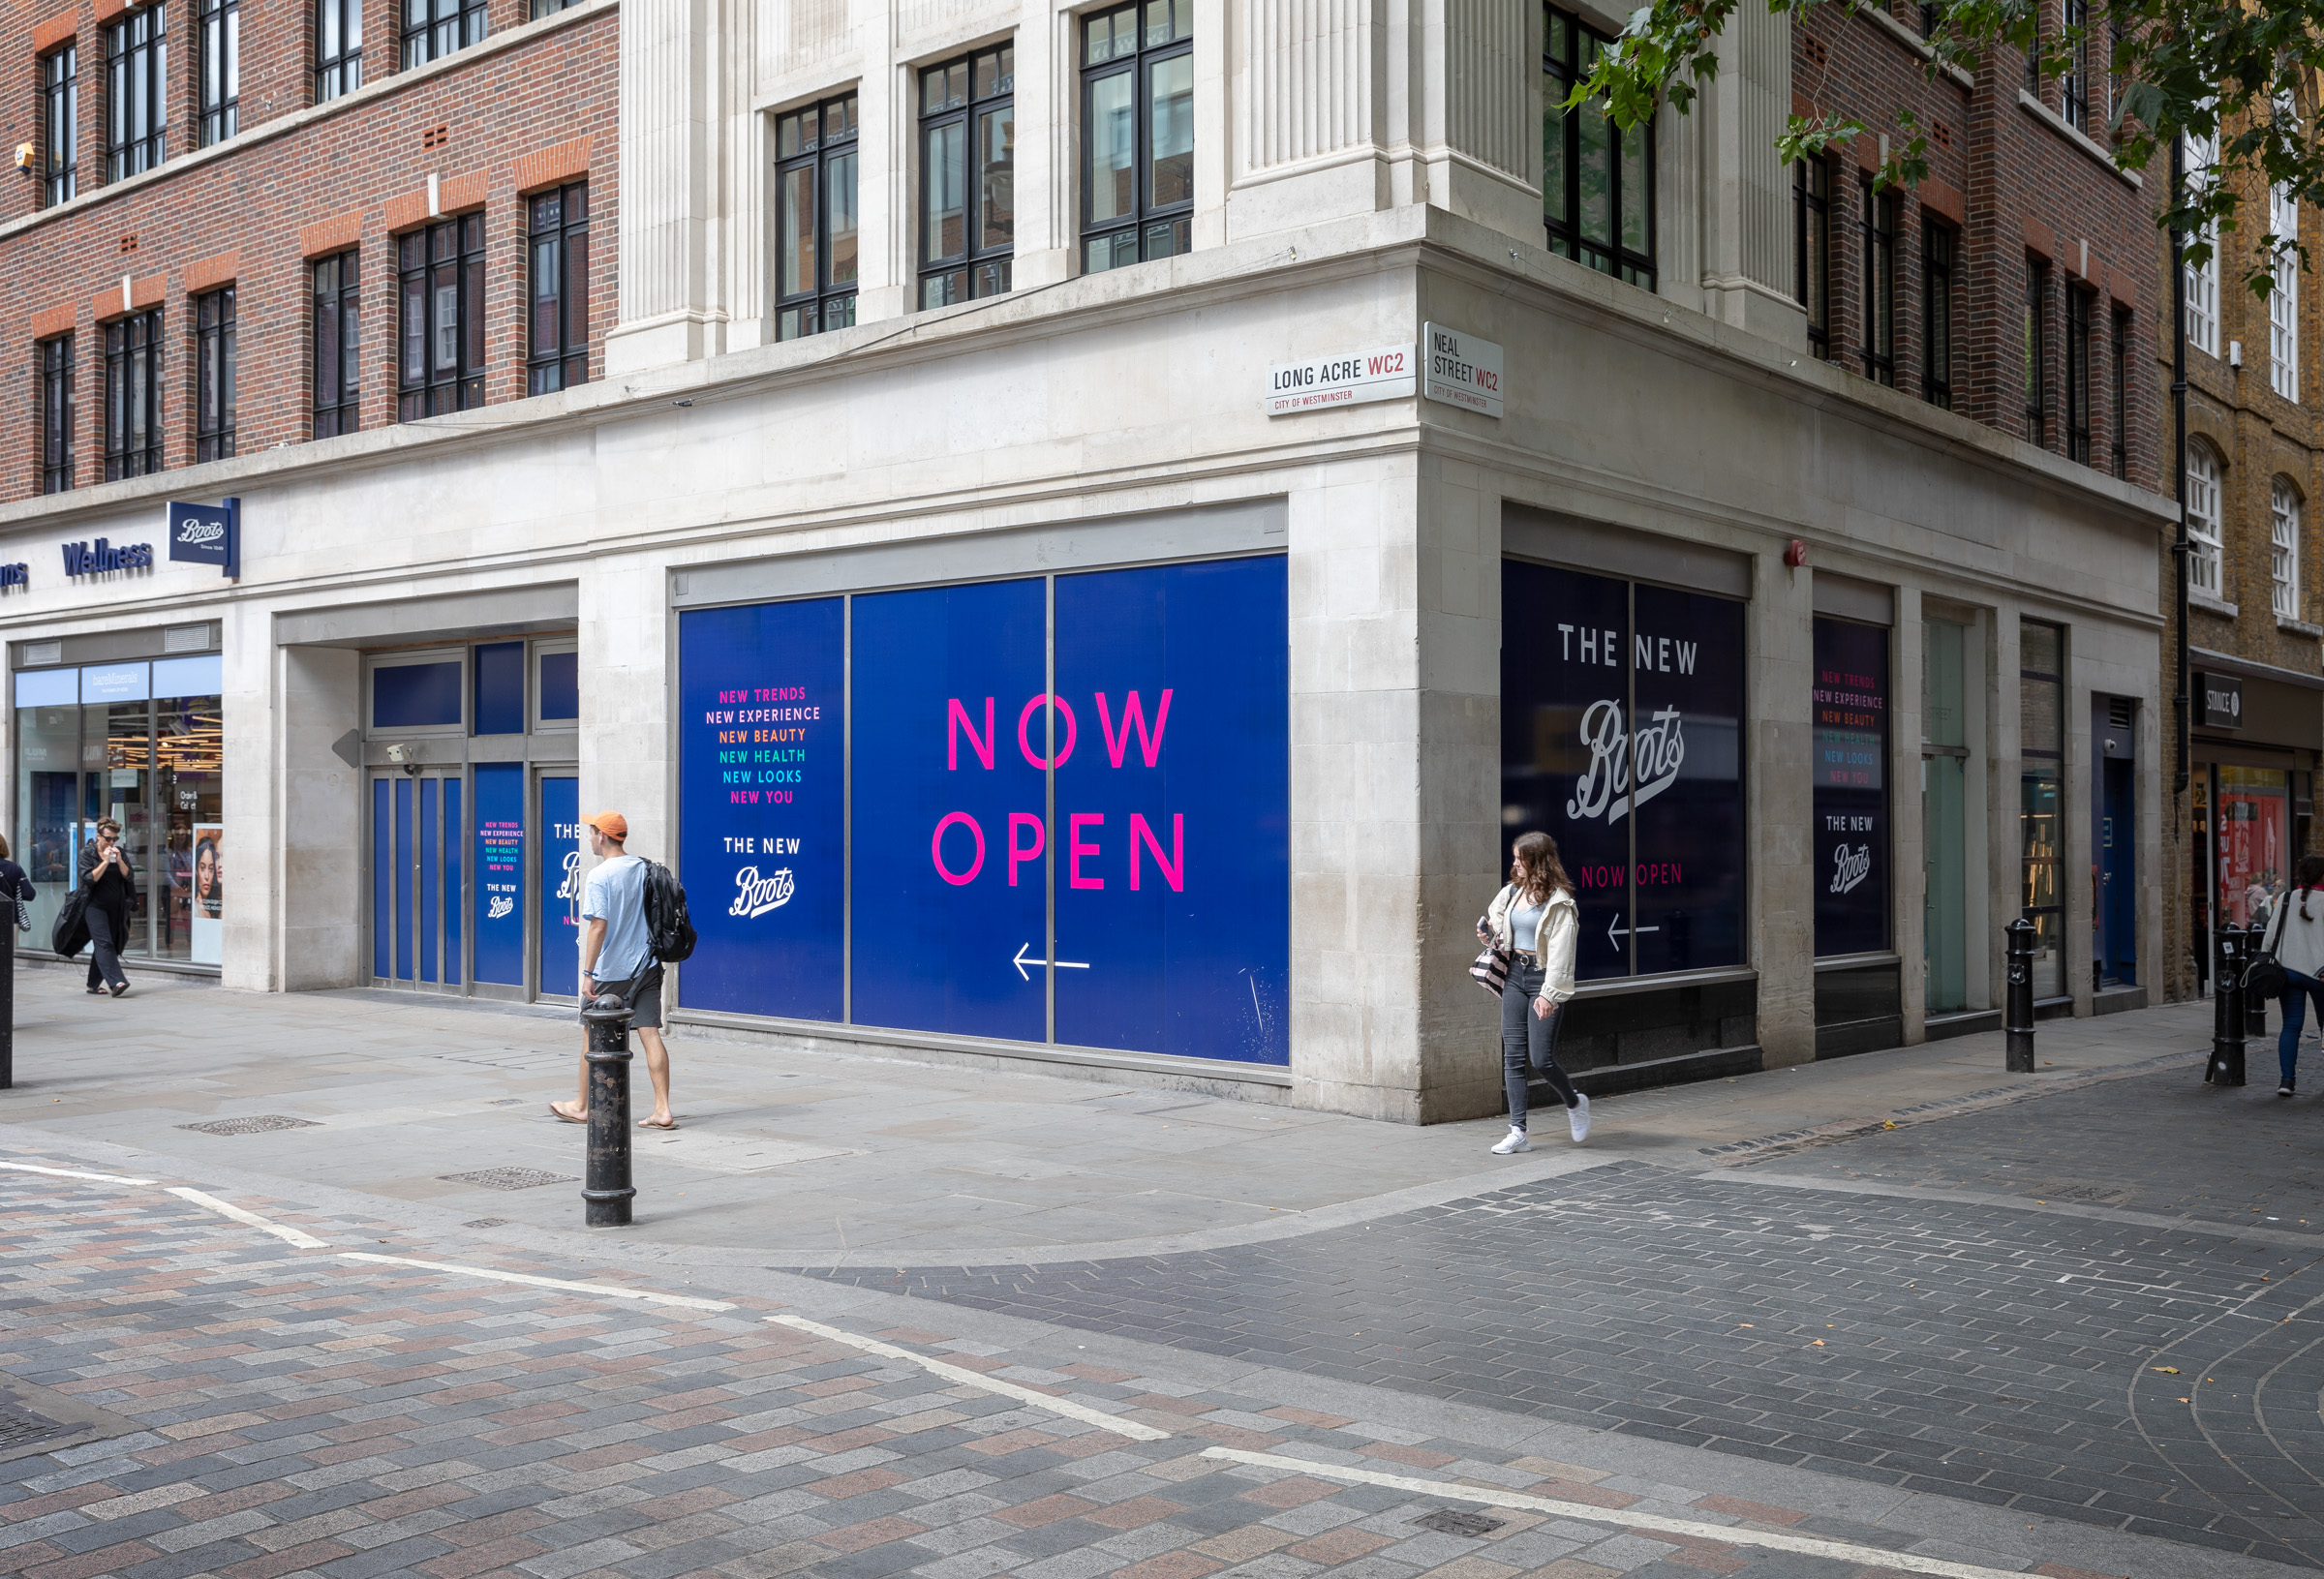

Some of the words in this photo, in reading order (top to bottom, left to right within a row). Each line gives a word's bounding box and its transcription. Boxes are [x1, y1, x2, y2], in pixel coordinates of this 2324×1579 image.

[1434, 332, 1460, 358] NEAL
[1274, 367, 1315, 390] LONG
[1320, 359, 1361, 383] ACRE
[1367, 352, 1404, 376] WC2
[1434, 355, 1474, 383] STREET
[1476, 368, 1499, 392] WC2
[1274, 399, 1290, 410] CITY
[1292, 396, 1301, 408] OF
[1302, 390, 1354, 407] WESTMINSTER
[1433, 384, 1446, 396] CITY
[1446, 387, 1453, 399] OF
[1453, 389, 1488, 410] WESTMINSTER
[176, 518, 225, 544] Boots
[62, 537, 153, 577] Wellness
[0, 562, 29, 587] ns
[1557, 622, 1617, 667] THE
[1636, 633, 1697, 676] NEW
[93, 671, 138, 685] bareMinerals
[1821, 670, 1841, 684] NEW
[1844, 673, 1875, 689] TRENDS
[719, 689, 749, 704] NEW
[753, 686, 806, 702] TRENDS
[1813, 689, 1832, 703] NEW
[1834, 691, 1882, 709] EXPERIENCE
[2207, 689, 2230, 714] STANCE
[706, 711, 734, 724] NEW
[739, 706, 820, 723] EXPERIENCE
[1821, 710, 1841, 724] NEW
[1844, 712, 1875, 727] BEAUTY
[719, 730, 748, 744] NEW
[753, 728, 806, 743] BEAUTY
[948, 688, 1174, 772] NOW
[1821, 730, 1841, 744] NEW
[1844, 732, 1875, 746] HEALTH
[719, 750, 749, 764] NEW
[753, 748, 806, 763] HEALTH
[1566, 698, 1685, 826] Boots
[1824, 750, 1843, 764] NEW
[1847, 751, 1873, 766] LOOKS
[722, 771, 751, 784] NEW
[758, 770, 802, 783] LOOKS
[1829, 770, 1849, 783] NEW
[1851, 771, 1869, 784] YOU
[730, 791, 760, 805] NEW
[765, 790, 793, 804] YOU
[1825, 815, 1847, 833] THE
[1850, 816, 1873, 832] NEW
[723, 836, 754, 854] THE
[763, 837, 801, 856] NEW
[932, 811, 1184, 893] OPEN
[1581, 865, 1626, 889] NOW
[1636, 862, 1682, 886] OPEN
[1829, 842, 1871, 895] Boots
[487, 883, 500, 892] THE
[501, 884, 516, 893] NEW
[728, 865, 795, 920] Boots
[487, 896, 514, 920] Boots
